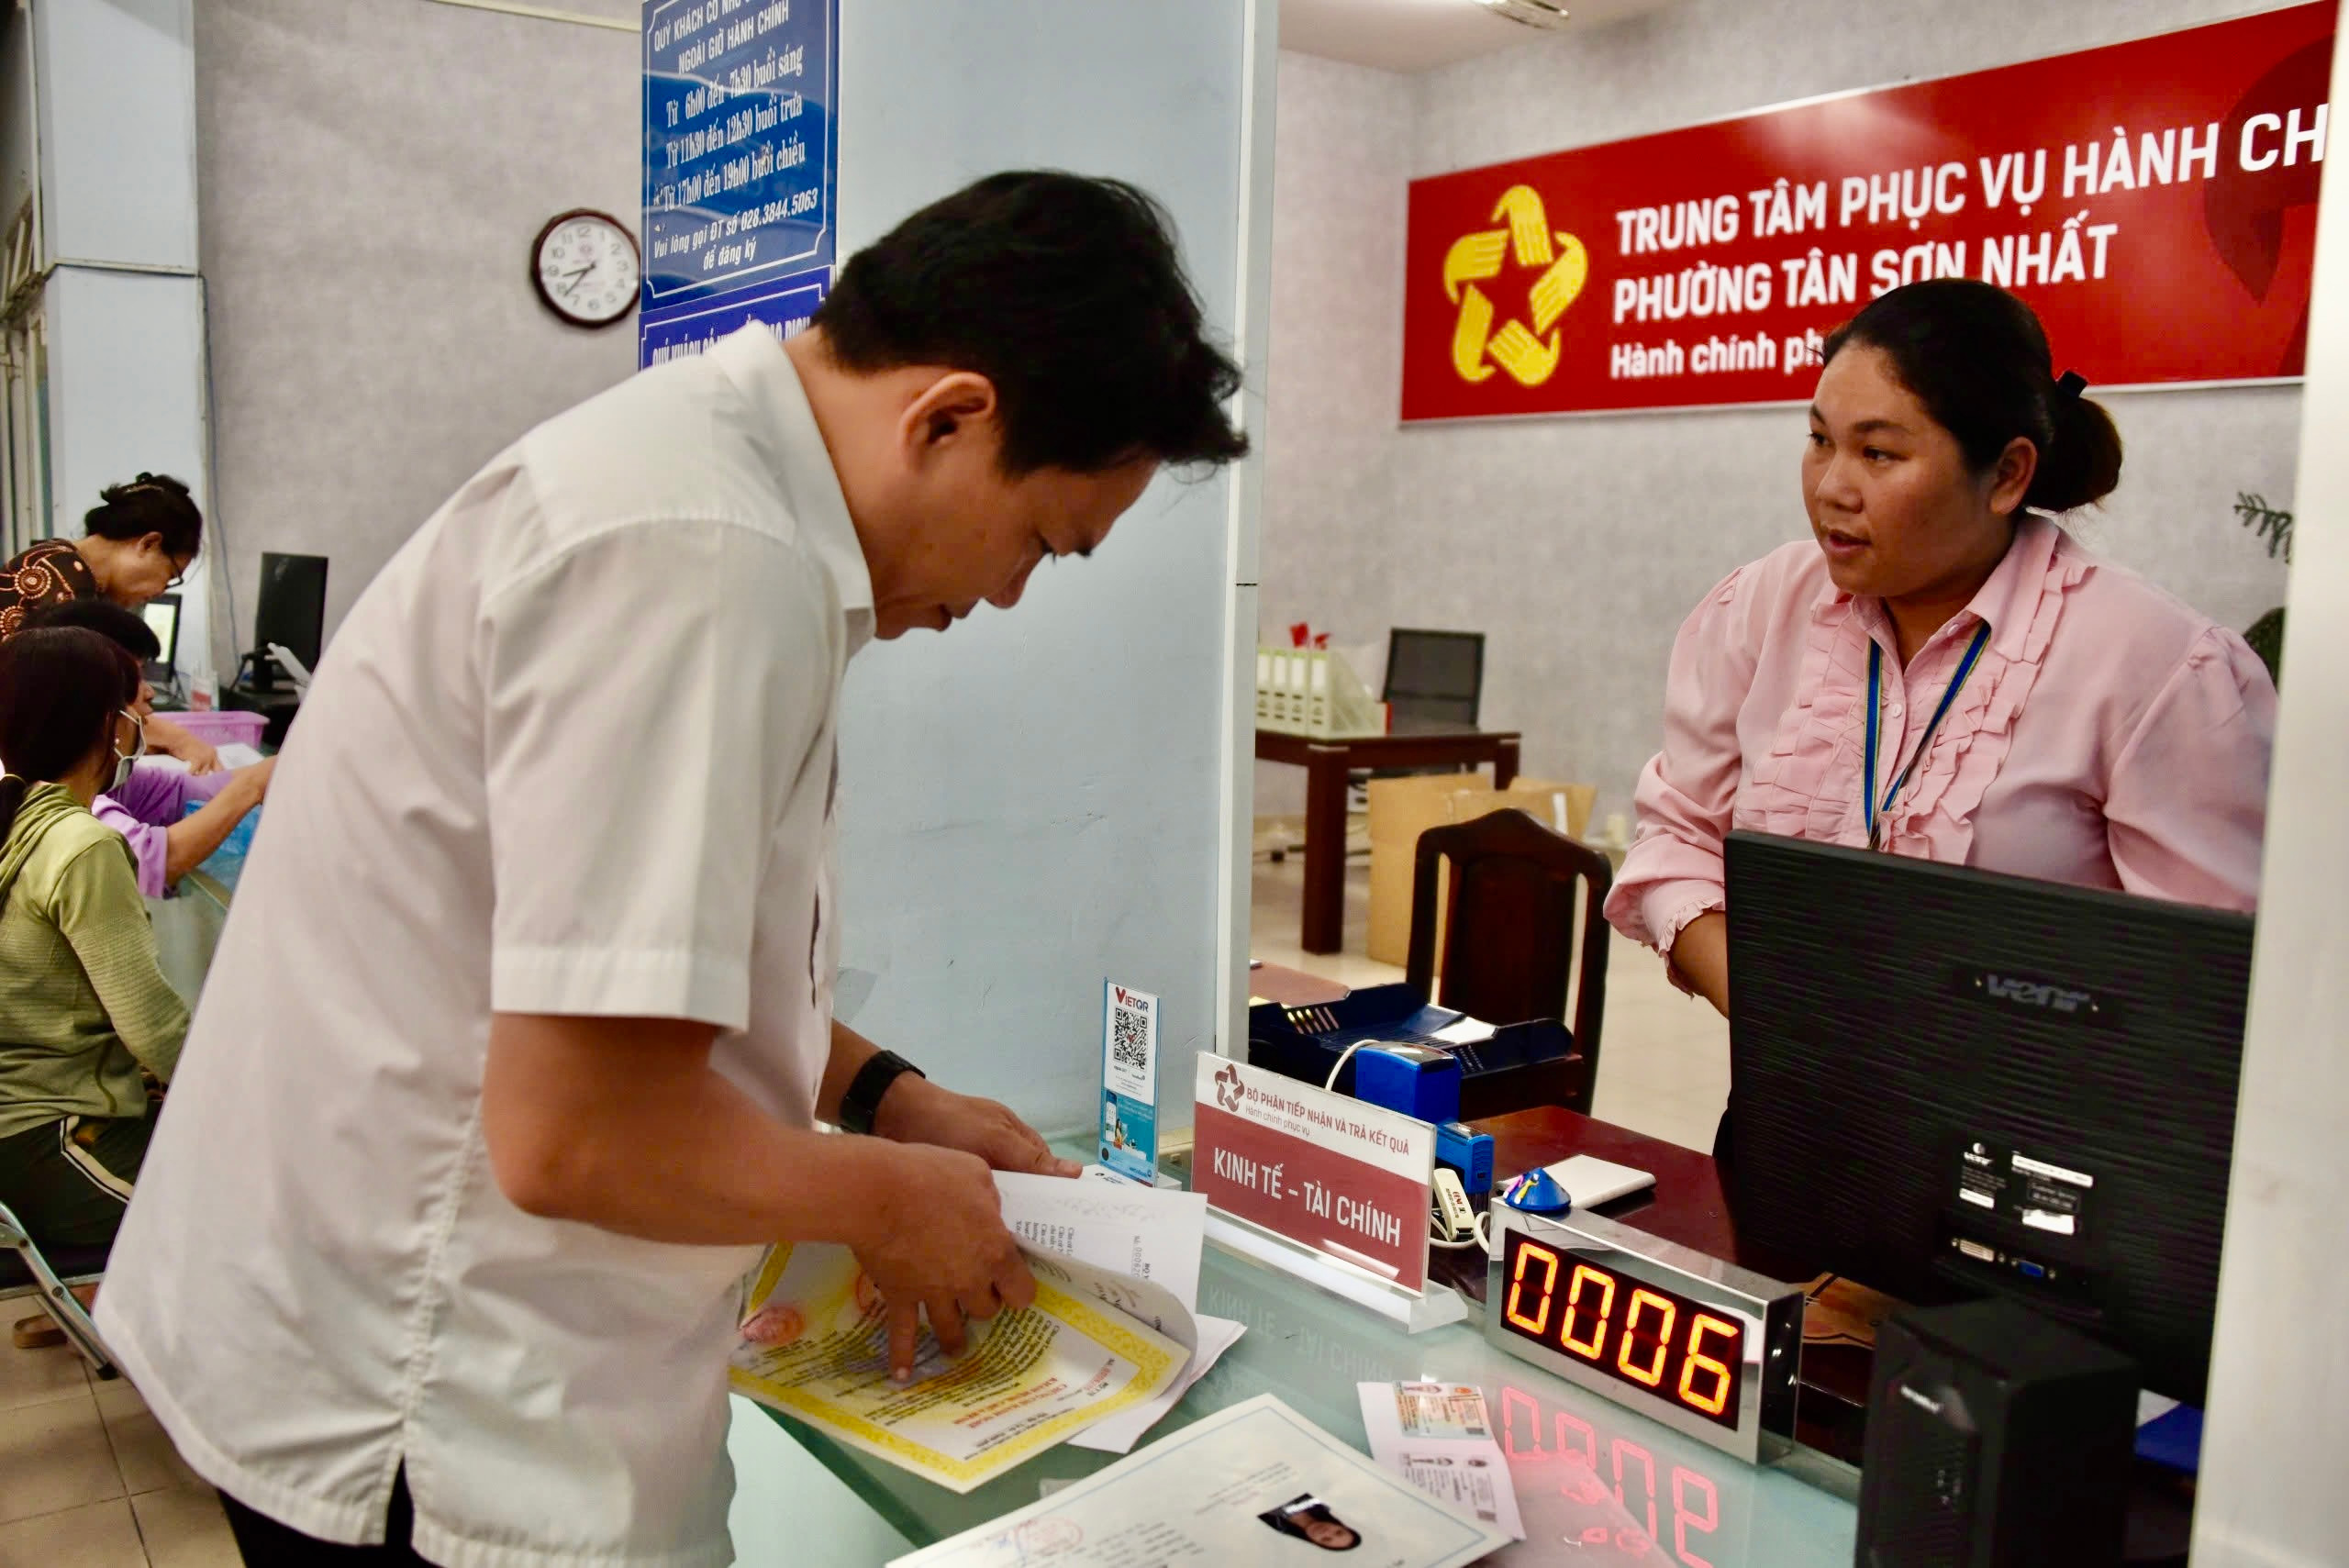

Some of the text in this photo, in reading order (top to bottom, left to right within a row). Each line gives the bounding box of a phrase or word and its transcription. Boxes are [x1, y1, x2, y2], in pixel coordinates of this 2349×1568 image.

[654, 21, 671, 51] QUÝ
[674, 6, 703, 41] KHÁCH
[679, 0, 789, 74] NGOÀI GIỜ HÀNH CHÍNH
[666, 44, 803, 128] Từ 6h00 đến 7h30 buổi sáng
[666, 91, 803, 169] Từ 11h30 đến 12h30 buổi trưa
[663, 129, 806, 212] Từ 17h00 đến 19h00 buổi chiều
[1615, 195, 1740, 255] TRUNG
[1748, 177, 1827, 238] TÂM
[1840, 162, 1967, 230] PHỤC
[1979, 149, 2047, 217] VỤ
[2063, 125, 2220, 198] HÀNH
[654, 187, 818, 258] Vui lòng gọi ĐT số 028.3844.5063
[704, 236, 757, 271] để đăng ký
[1614, 209, 2118, 323] PHƯỜNG TÂN SƠN NHẤT
[1610, 339, 1685, 380] Hành
[1690, 330, 1776, 374] chính
[1115, 986, 1149, 1013] VIETQR
[1245, 1105, 1310, 1137] Hành chính phục vụ
[1246, 1087, 1409, 1156] BỘ PHẬN TIẾP NHẬN VÀ TRẢ KẾT QUẢ
[1214, 1147, 1257, 1189] KINH
[1261, 1162, 1285, 1200] TẾ
[1303, 1180, 1330, 1219] TÀI
[1336, 1195, 1401, 1248] CHÍNH
[1506, 1241, 1740, 1416] 0006
